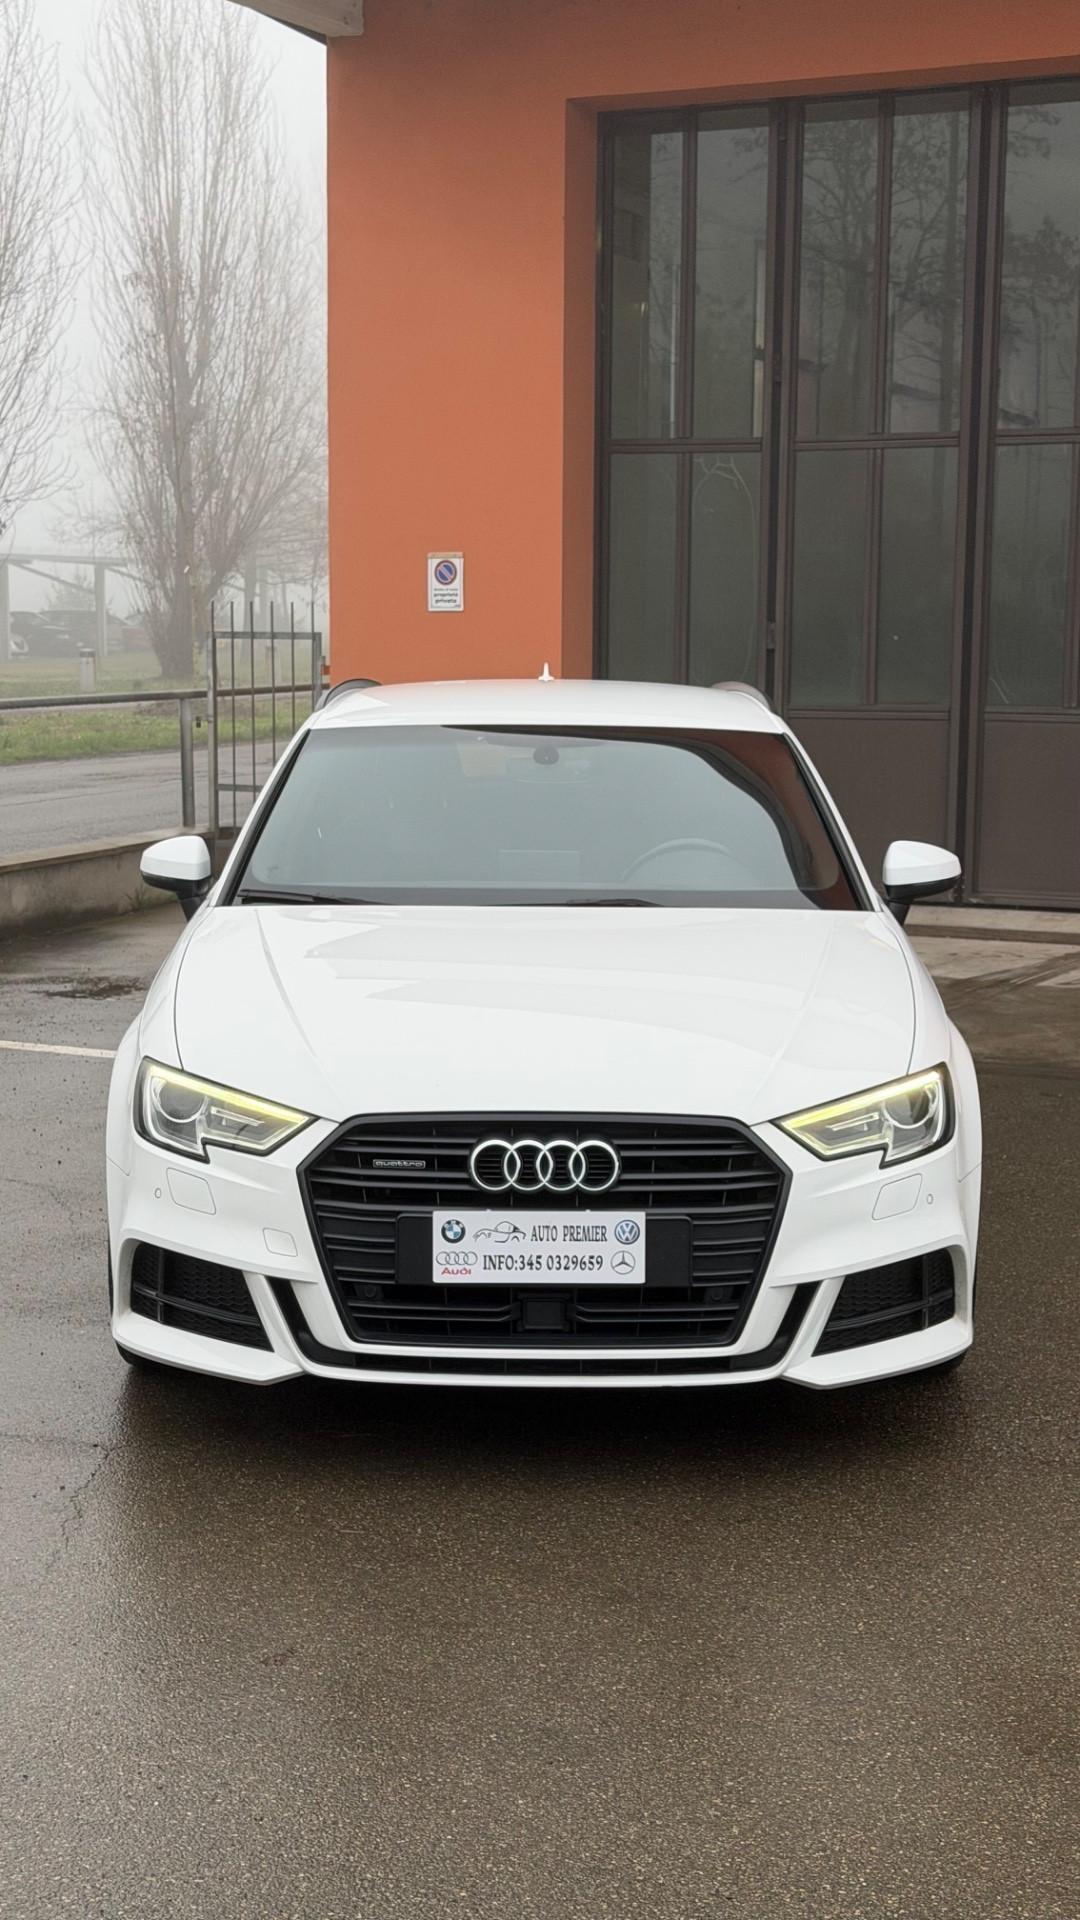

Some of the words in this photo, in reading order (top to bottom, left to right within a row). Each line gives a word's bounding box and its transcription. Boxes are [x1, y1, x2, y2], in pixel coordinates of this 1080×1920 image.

[530, 1225, 558, 1242] AUTO
[562, 1225, 607, 1242] PREMIER
[441, 1267, 472, 1275] Audi
[483, 1254, 542, 1271] INFO:345
[546, 1254, 604, 1271] 0329659
